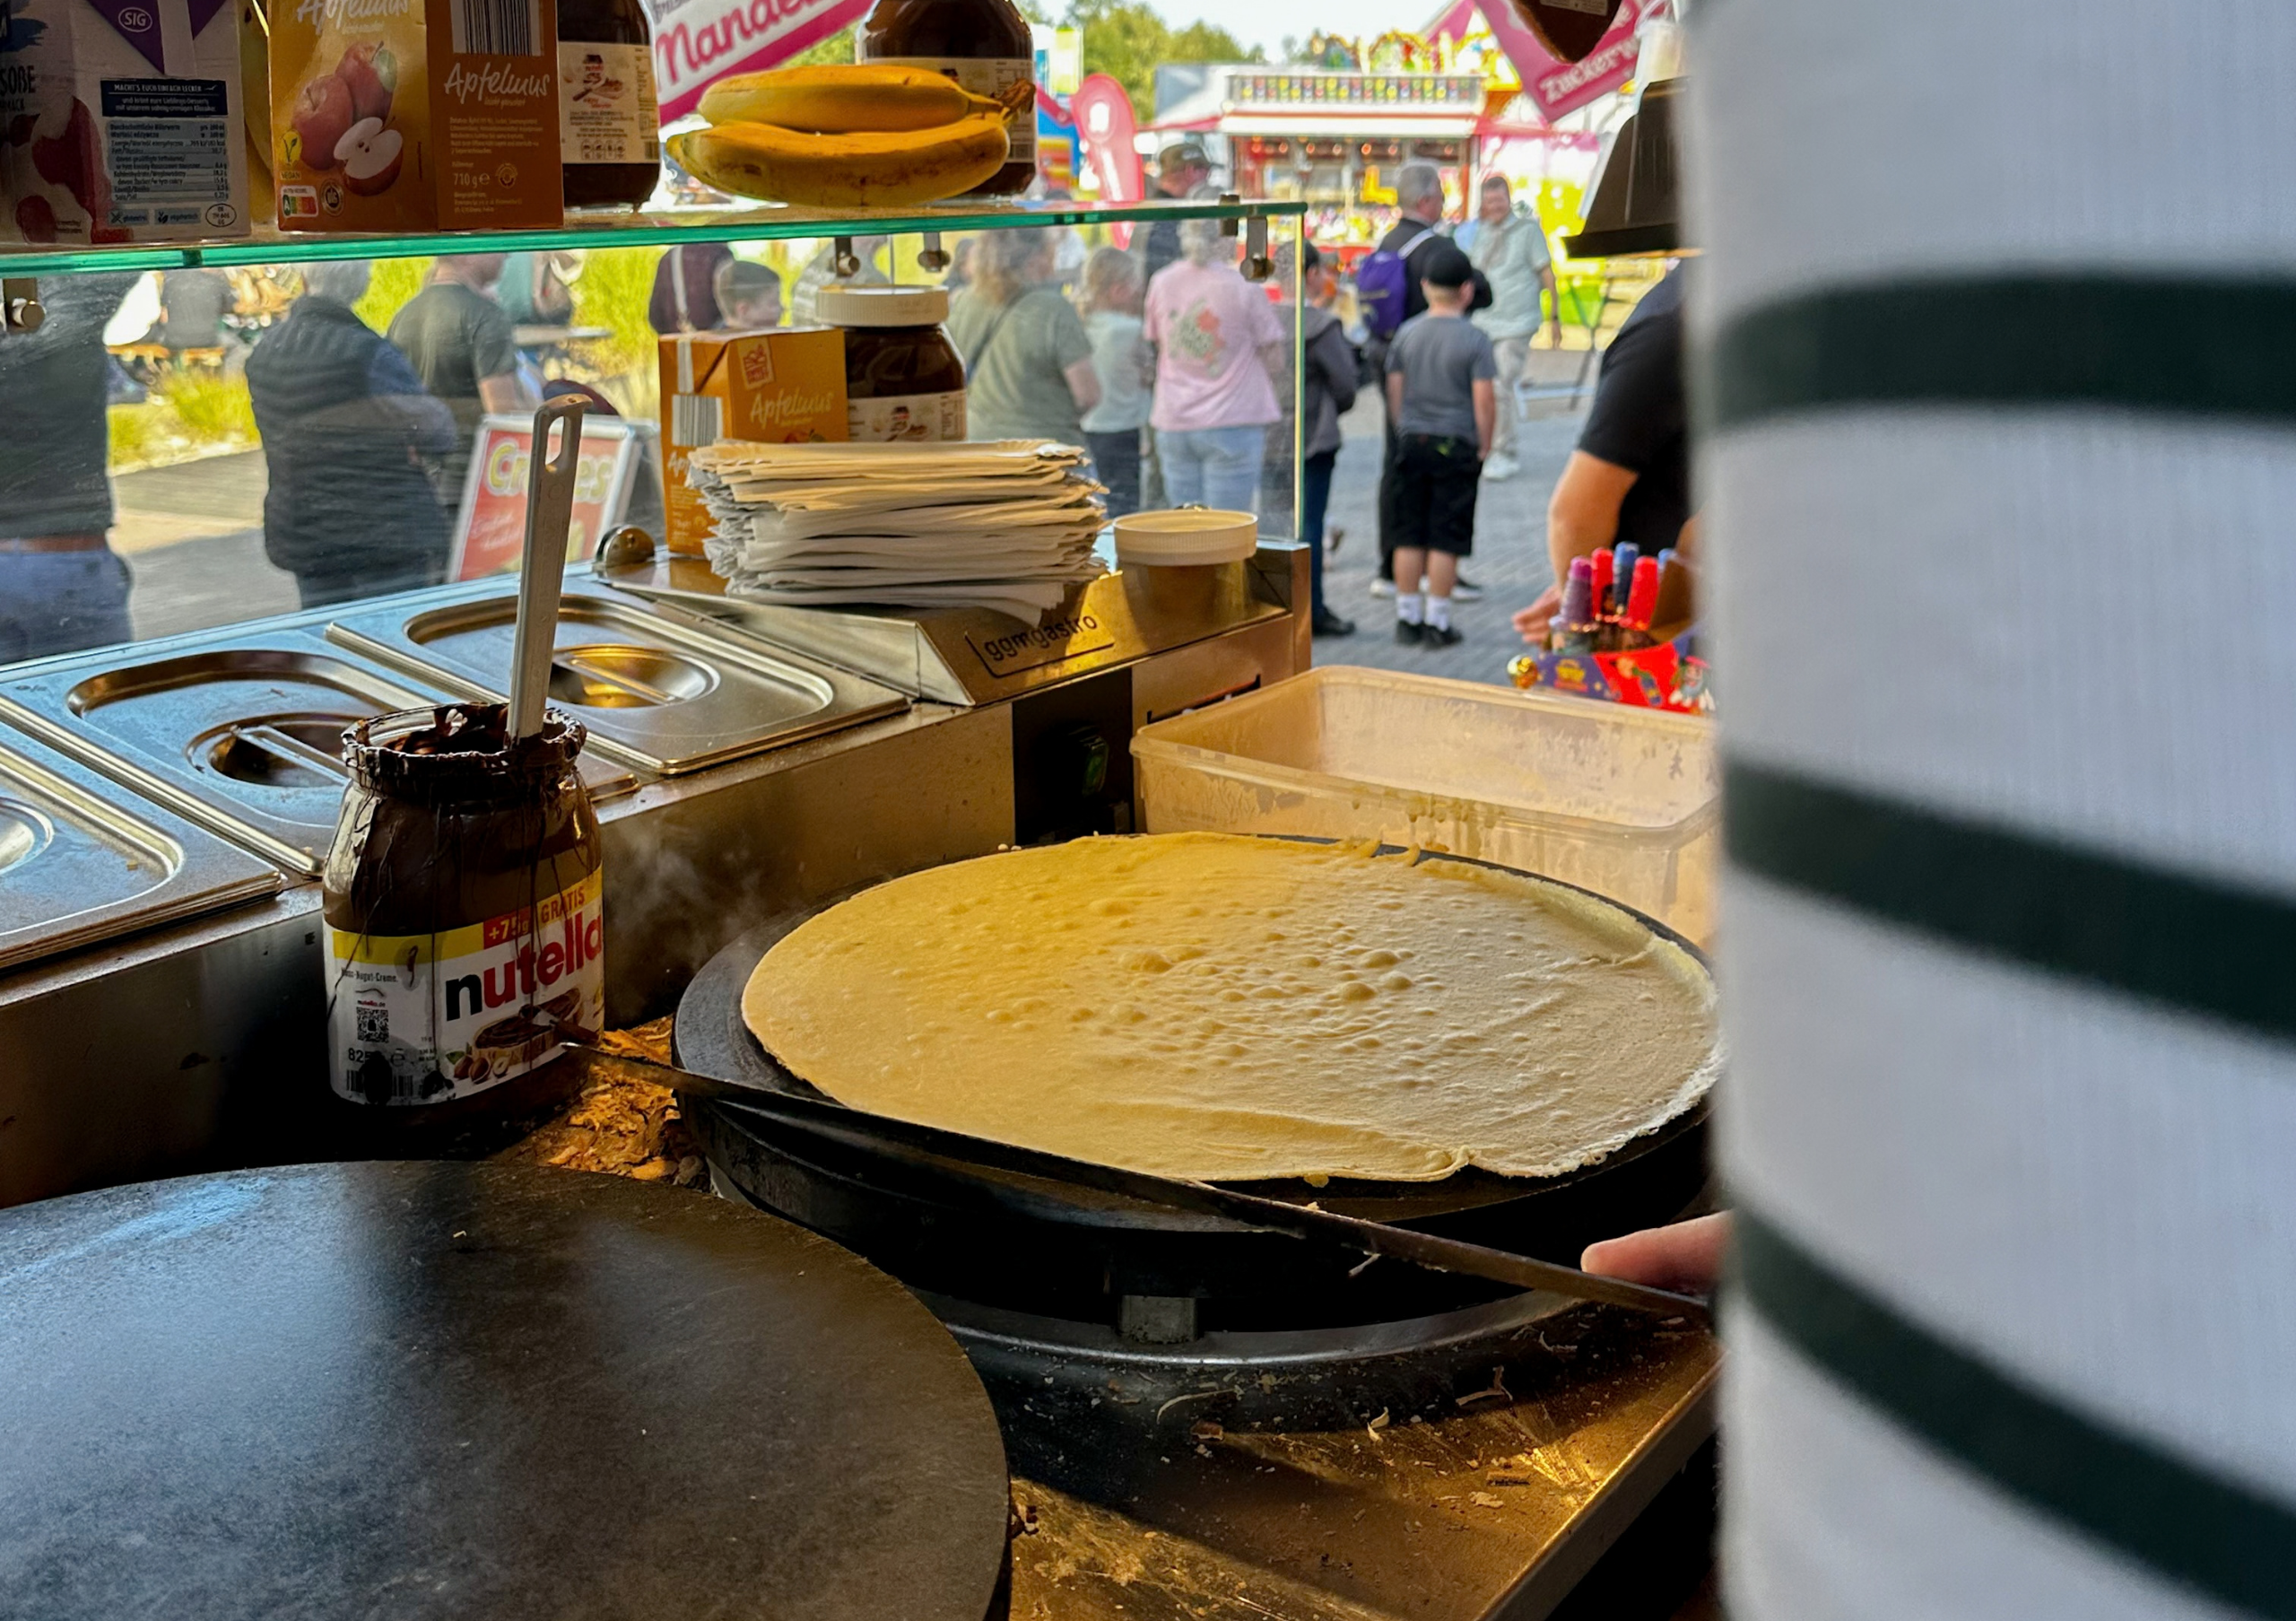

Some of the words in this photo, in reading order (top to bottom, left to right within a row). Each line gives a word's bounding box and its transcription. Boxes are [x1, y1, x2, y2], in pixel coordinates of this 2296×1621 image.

[124, 13, 146, 26] SIG
[444, 62, 550, 104] Apfelmus
[453, 172, 470, 186] 710
[984, 613, 1098, 661] ggmgastro
[541, 885, 586, 923] GRATIS
[446, 911, 602, 1022] nutella
